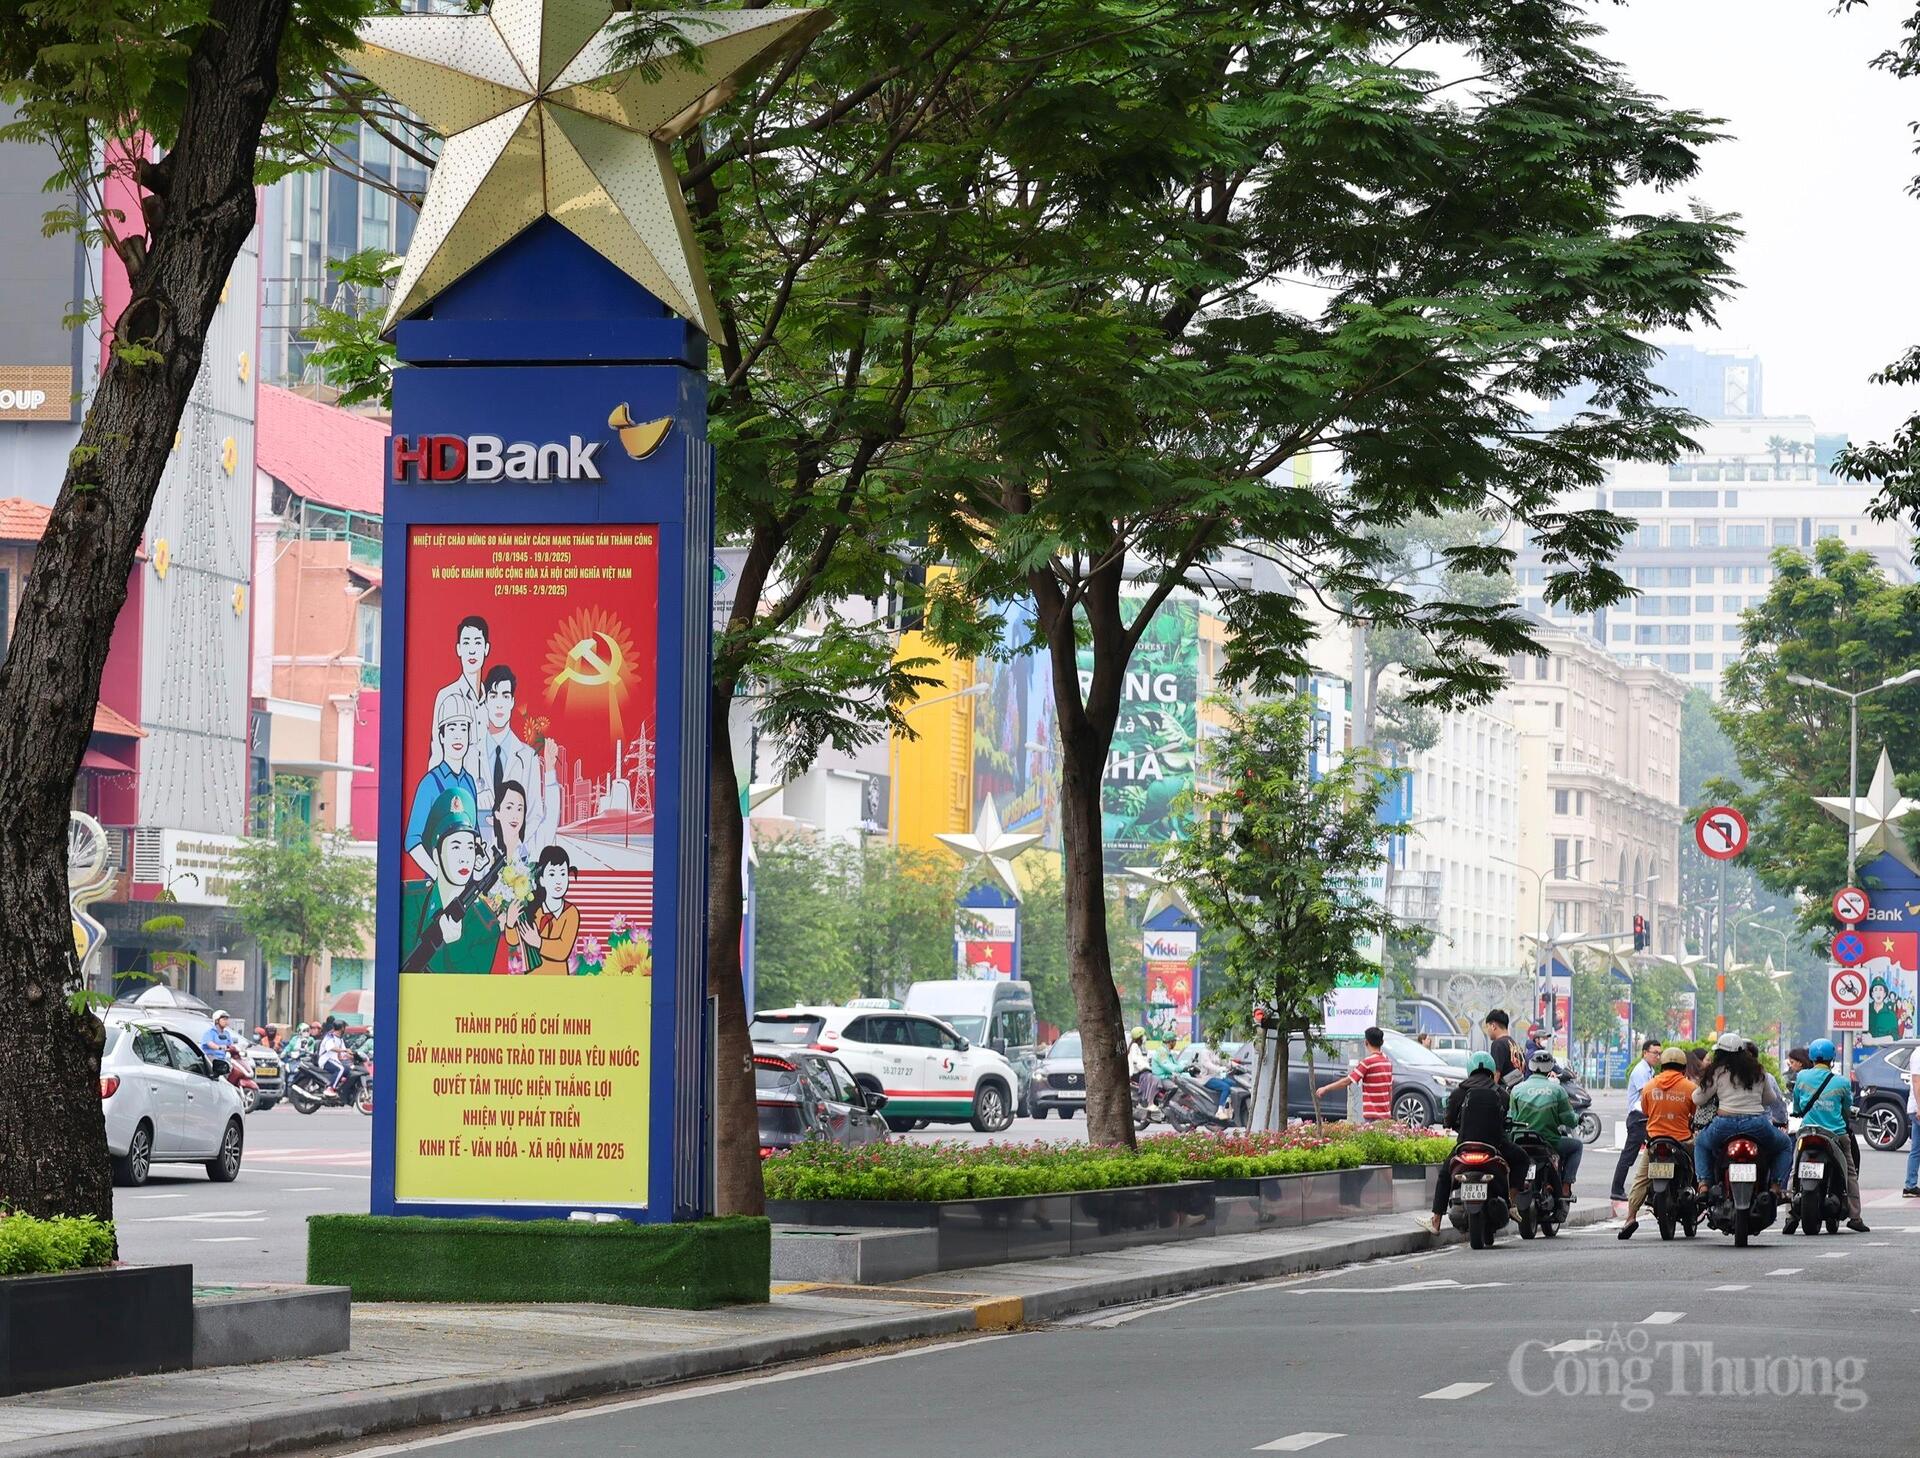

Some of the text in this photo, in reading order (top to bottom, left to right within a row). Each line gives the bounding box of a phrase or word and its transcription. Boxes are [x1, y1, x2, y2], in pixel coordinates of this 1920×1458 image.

[393, 434, 604, 484] HDBank
[413, 533, 653, 548] NHIỆT LIỆT CHÀO MỪNG 80 NĂM NGÀY CÁCH MẠNG THÁNG TÁM THÀNH CÔNG
[492, 552, 529, 563] (19/8/1945
[534, 552, 571, 563] 19/8/2025)
[431, 565, 632, 581] VÀ QUỐC KHÁNH NƯỚC CỘNG HÒA XÃ HỘI CHỦ NGHĨA VIỆT NAM
[495, 585, 527, 596] (2/9/1945
[533, 585, 567, 596] 2/9/2025)
[1134, 642, 1167, 651] OREST
[1077, 670, 1178, 703] RNG
[1104, 744, 1164, 780] HÀ
[1867, 908, 1903, 922] Bank
[1145, 937, 1178, 956] Vikki
[455, 1012, 591, 1035] THÀNH PHỐ HỒ CHÍ MINH
[1840, 1009, 1857, 1019] CẤM
[408, 1040, 639, 1068] ĐẨY MẠNH PHONG TRÀO THI ĐUA YÊU NƯỚC
[433, 1073, 611, 1101] QUYẾT TÂM THỰC HIỆN THẮNG LỢI
[1527, 1087, 1553, 1096] Grab
[463, 1104, 581, 1130] NHIỆM VỤ PHÁT TRIỂN
[419, 1139, 445, 1156] KINH
[449, 1134, 462, 1157] TẾ
[471, 1136, 492, 1157] VĂN
[495, 1136, 518, 1158] HÓA
[529, 1137, 543, 1158] XÃ
[546, 1138, 566, 1162] HỘI
[569, 1138, 593, 1159] NĂM
[596, 1143, 625, 1160] 2025
